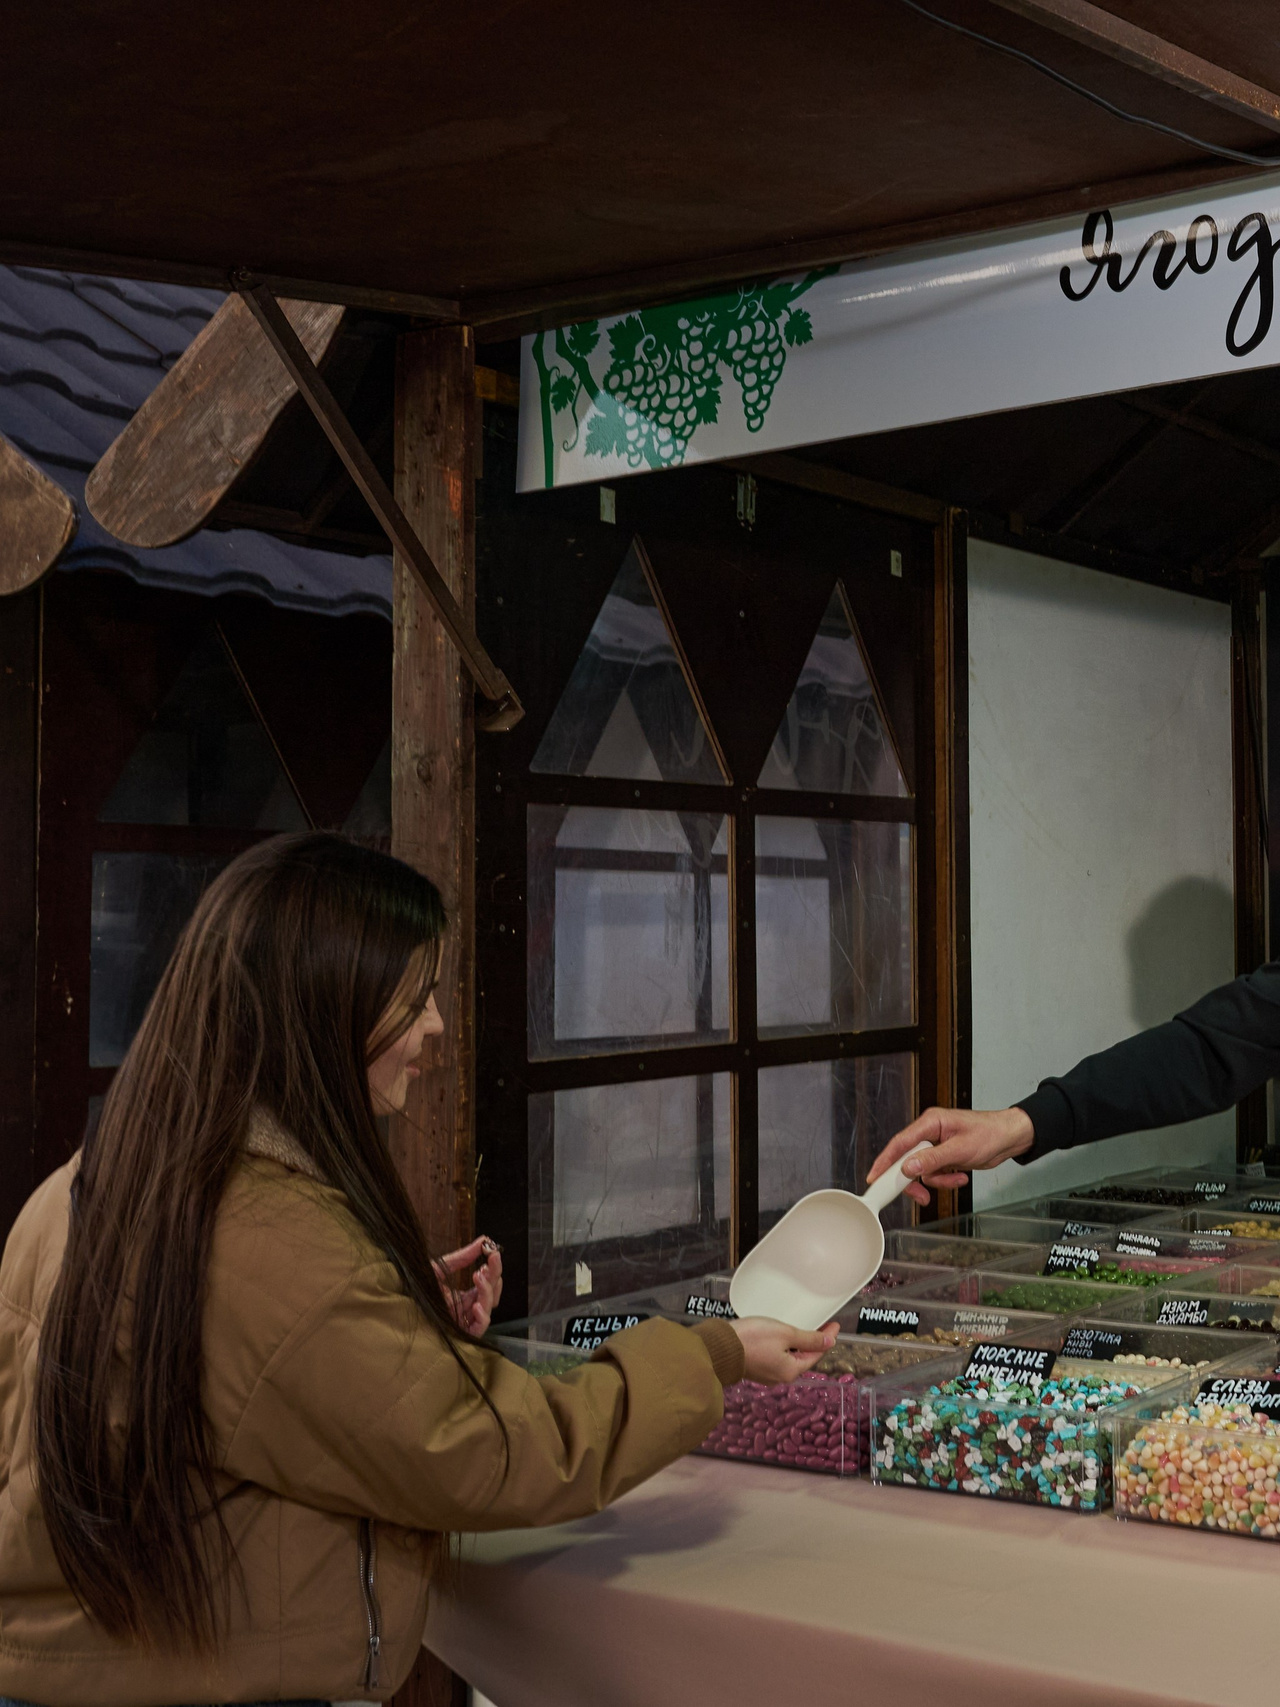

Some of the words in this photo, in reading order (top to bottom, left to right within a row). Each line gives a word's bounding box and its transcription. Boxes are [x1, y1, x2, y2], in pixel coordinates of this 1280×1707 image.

[1050, 1243, 1100, 1262] МИНДАЛЬ
[1047, 1255, 1088, 1269] МАТЧА
[1161, 1300, 1201, 1313] ИЗЮМ
[572, 1315, 639, 1333] КЕШЬЮ
[859, 1306, 920, 1325] МИНДАЛЬ
[1156, 1309, 1208, 1325] ДЖАМБО
[1067, 1329, 1122, 1346] ЭКЗОТИКА
[974, 1344, 1049, 1369] МОРСКИЕ
[1211, 1378, 1270, 1395] СЛЁЗЫ
